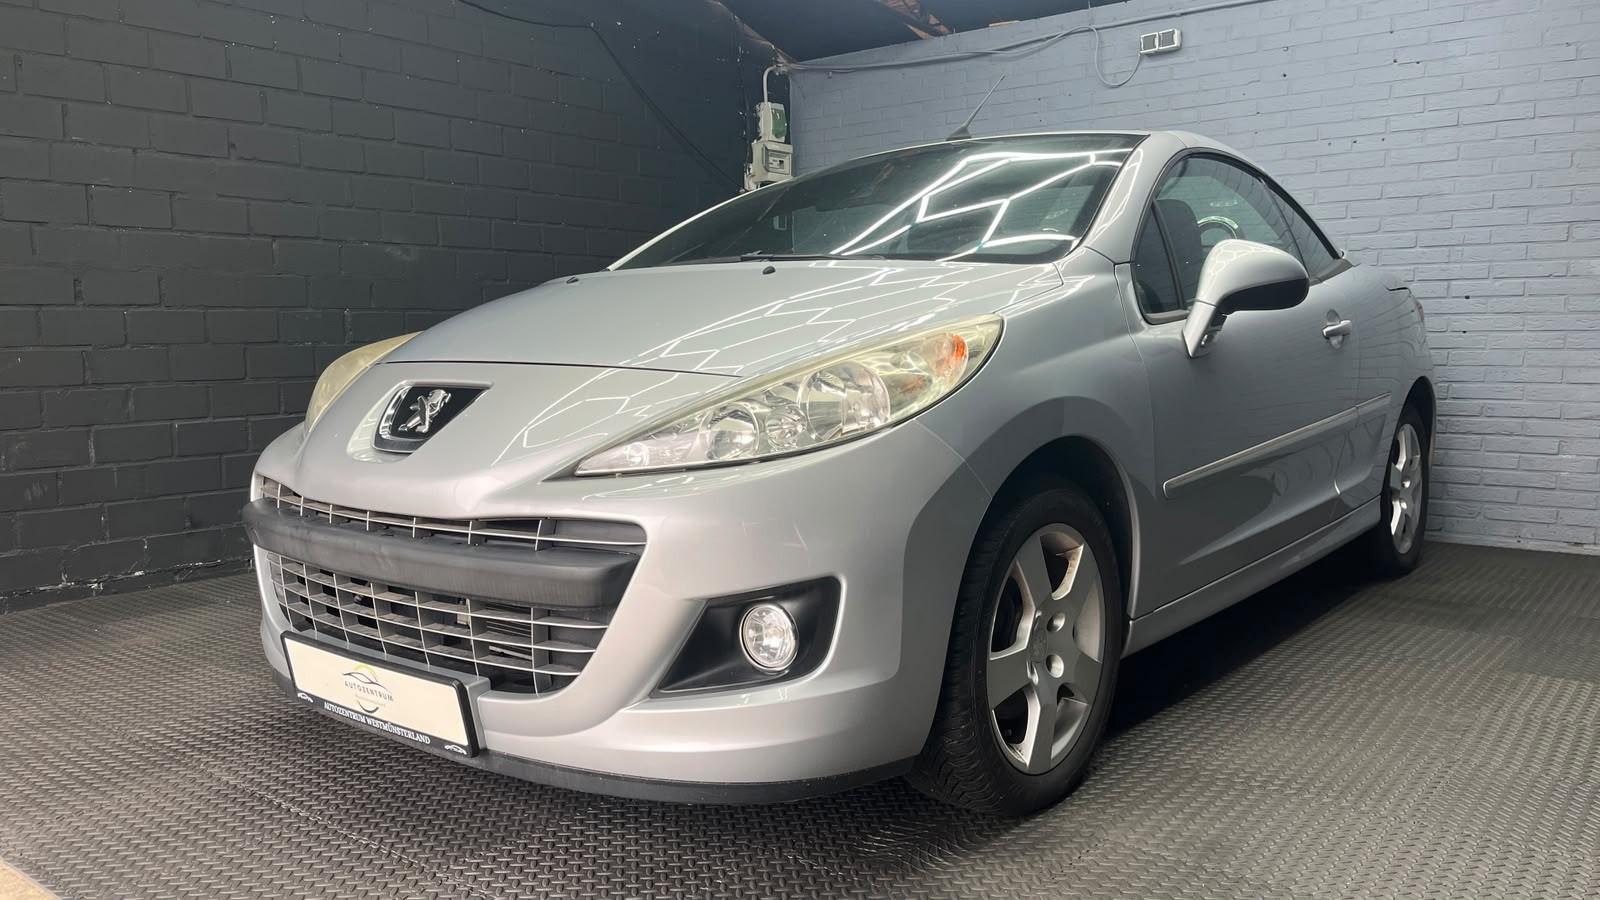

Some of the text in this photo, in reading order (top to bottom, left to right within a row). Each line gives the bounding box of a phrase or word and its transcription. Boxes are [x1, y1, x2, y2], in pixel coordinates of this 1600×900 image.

[344, 680, 394, 702] AUTOZENTRUM
[324, 701, 431, 744] AUTOZENTRUM WESTMÜNSTERLAND
